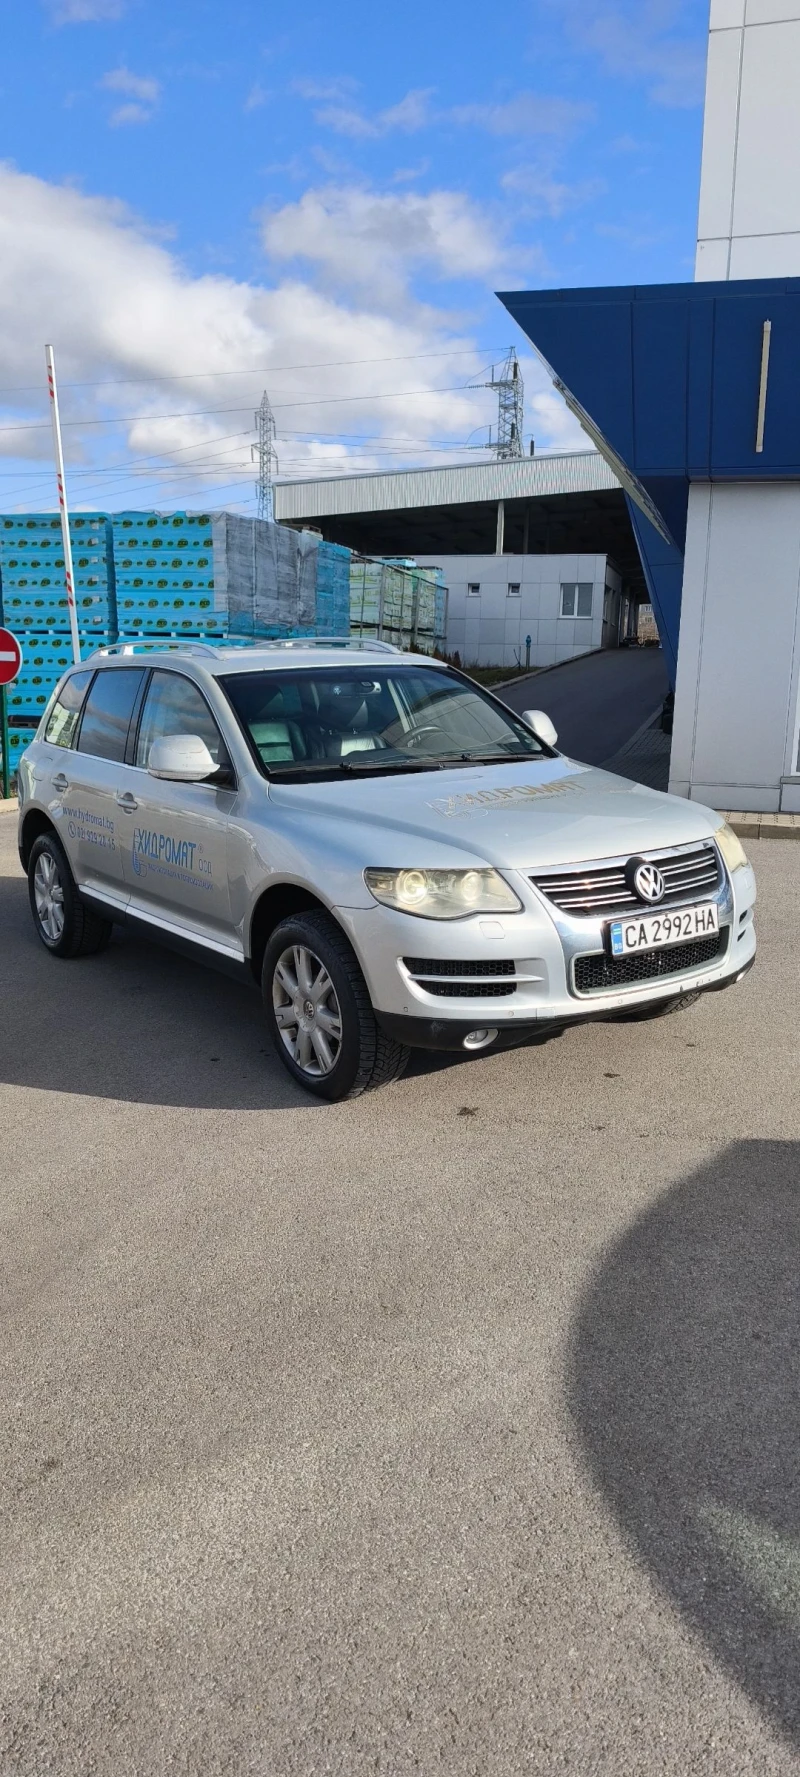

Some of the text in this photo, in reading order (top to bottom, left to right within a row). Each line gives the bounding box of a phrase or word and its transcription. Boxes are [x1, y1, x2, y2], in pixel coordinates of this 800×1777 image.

[138, 829, 196, 870] ХИДРОМАТ
[625, 908, 715, 948] CA 2992 HA
